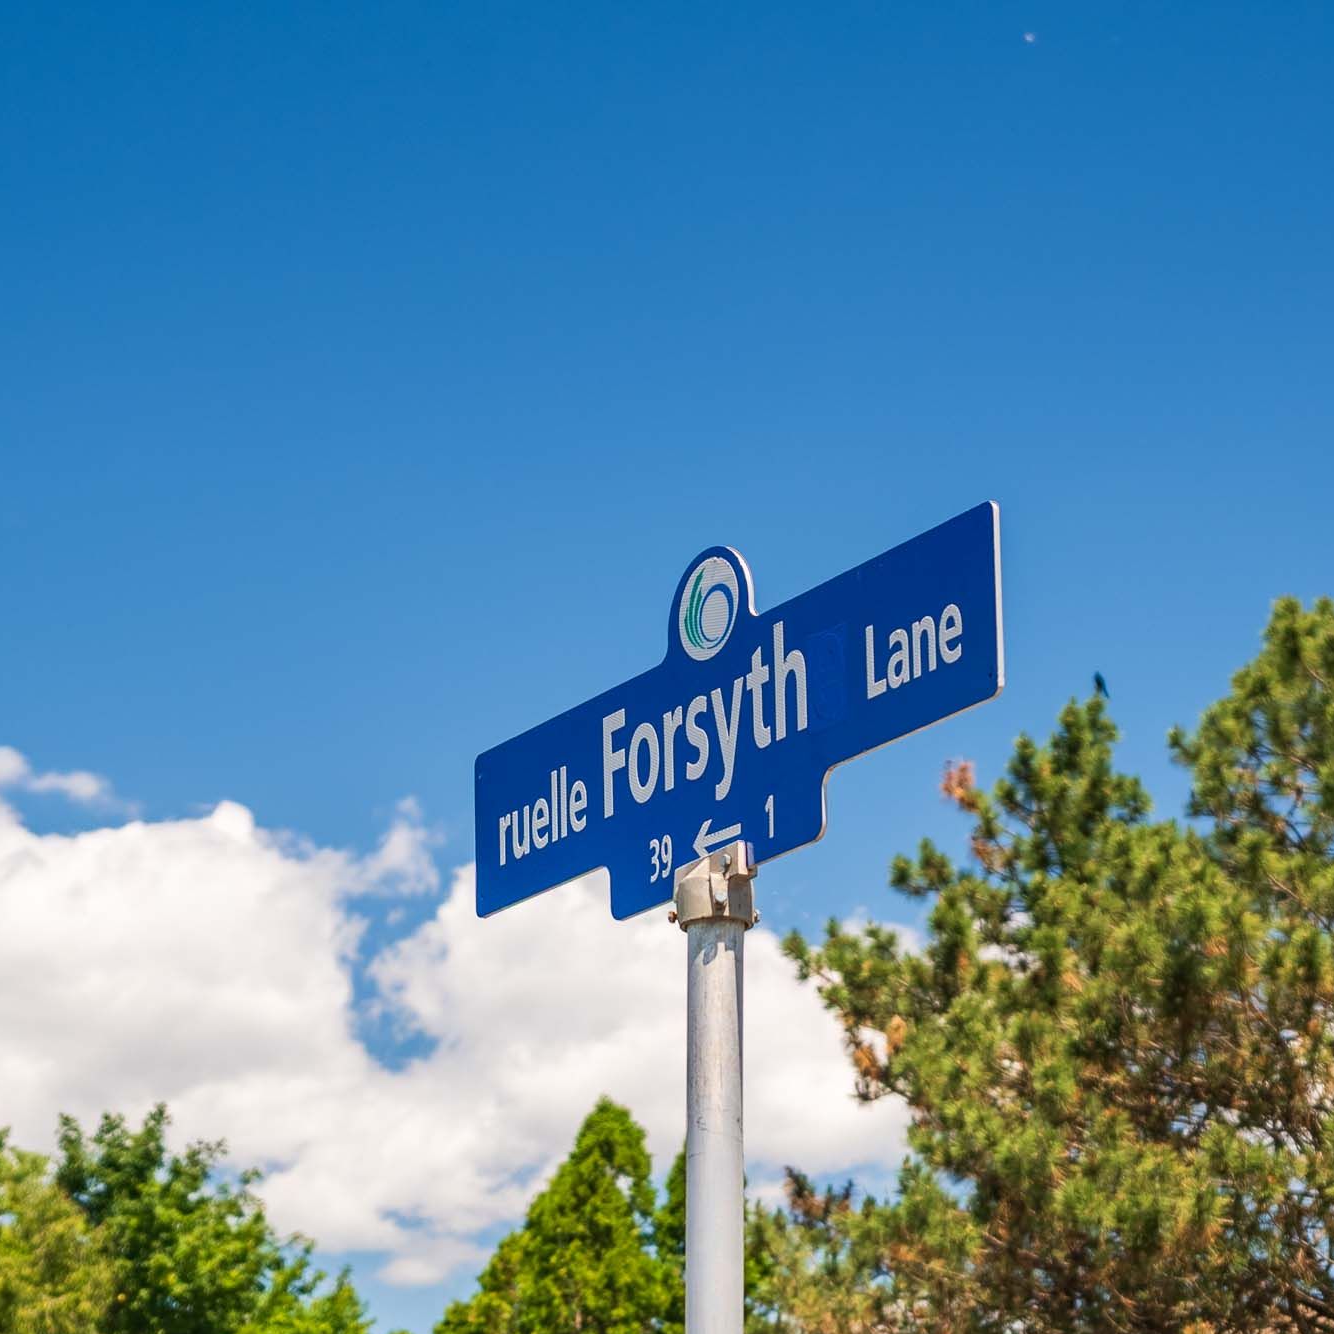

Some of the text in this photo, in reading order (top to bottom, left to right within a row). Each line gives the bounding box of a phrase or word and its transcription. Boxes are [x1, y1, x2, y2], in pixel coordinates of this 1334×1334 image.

[499, 604, 963, 866] ruelle Forsyth Lane
[650, 795, 775, 883] 39 1
